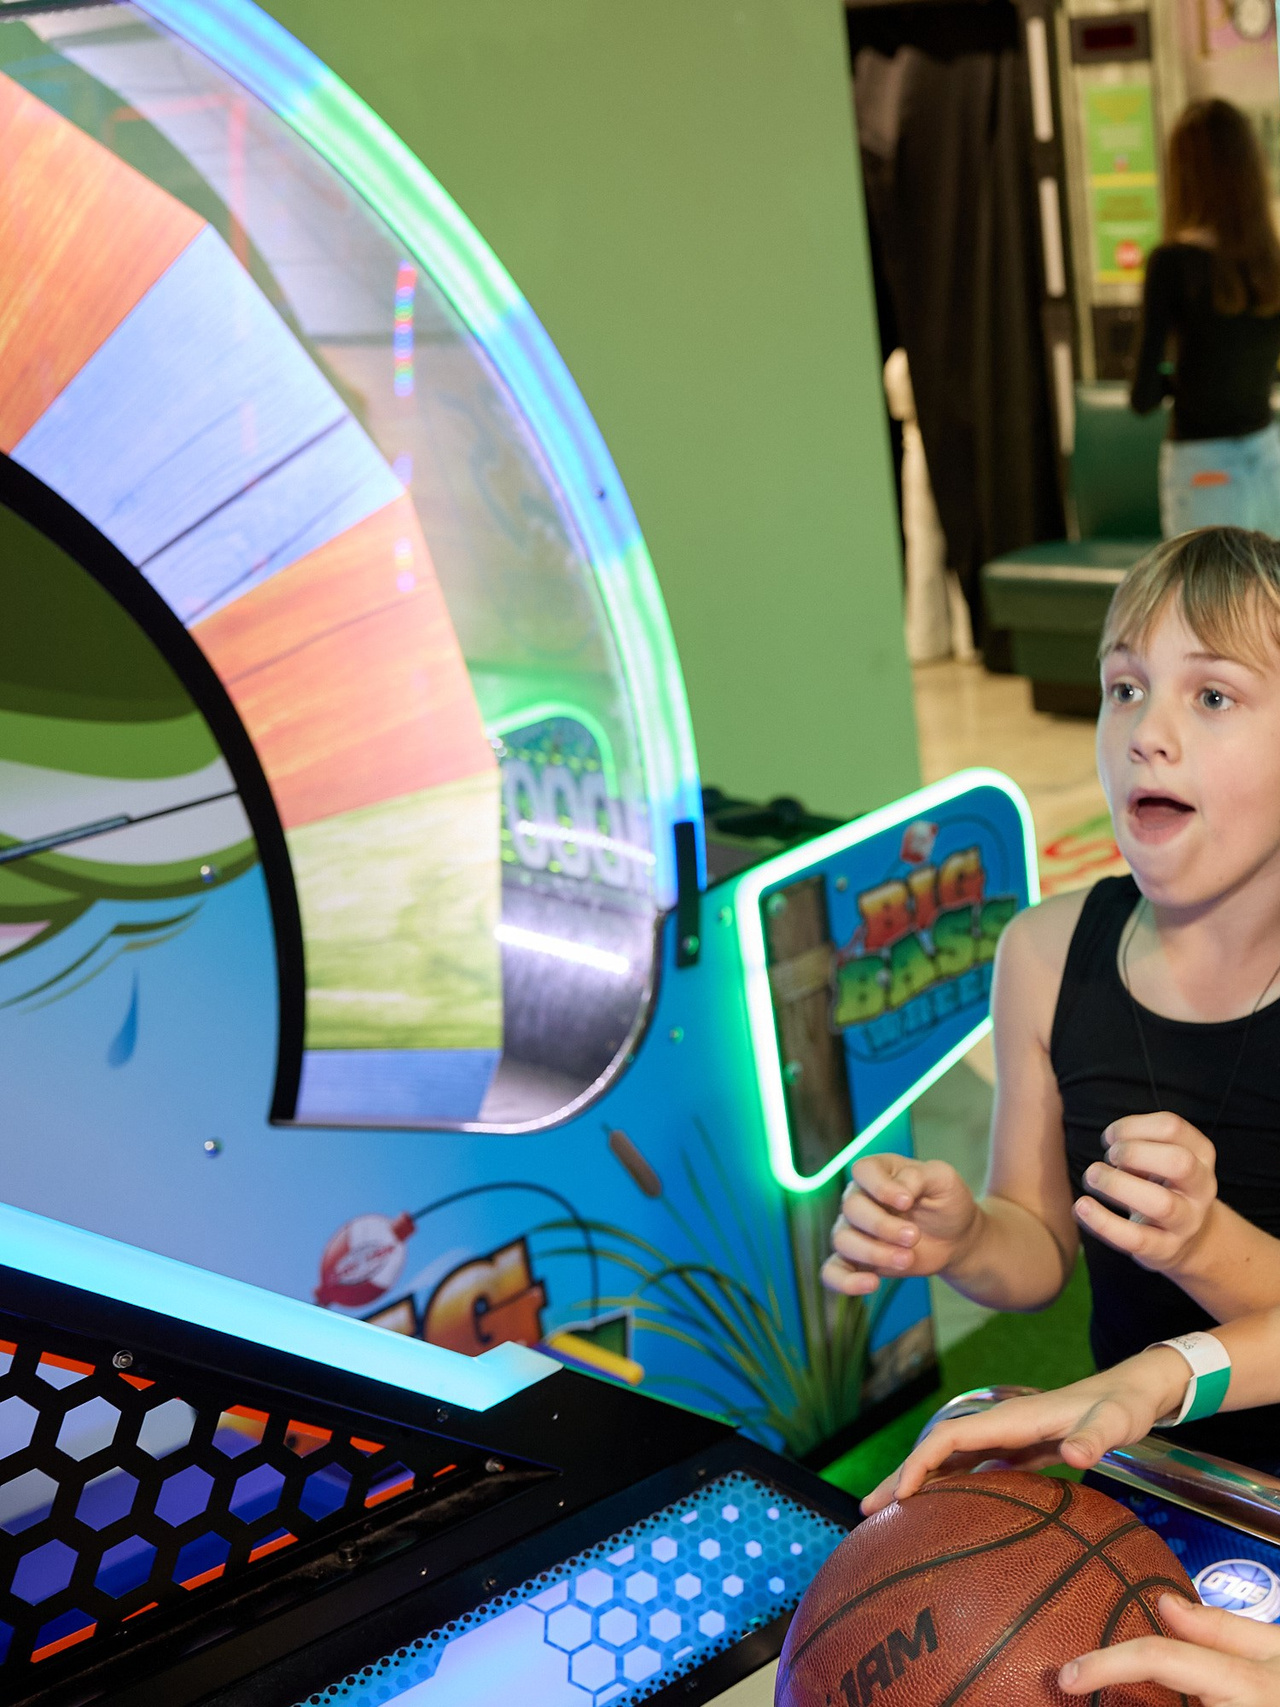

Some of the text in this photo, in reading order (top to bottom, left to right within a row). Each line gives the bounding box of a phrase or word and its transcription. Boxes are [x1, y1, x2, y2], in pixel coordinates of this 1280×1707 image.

[858, 846, 985, 953] BIG
[834, 897, 1016, 1027] BASS
[1200, 1570, 1270, 1604] SOLO
